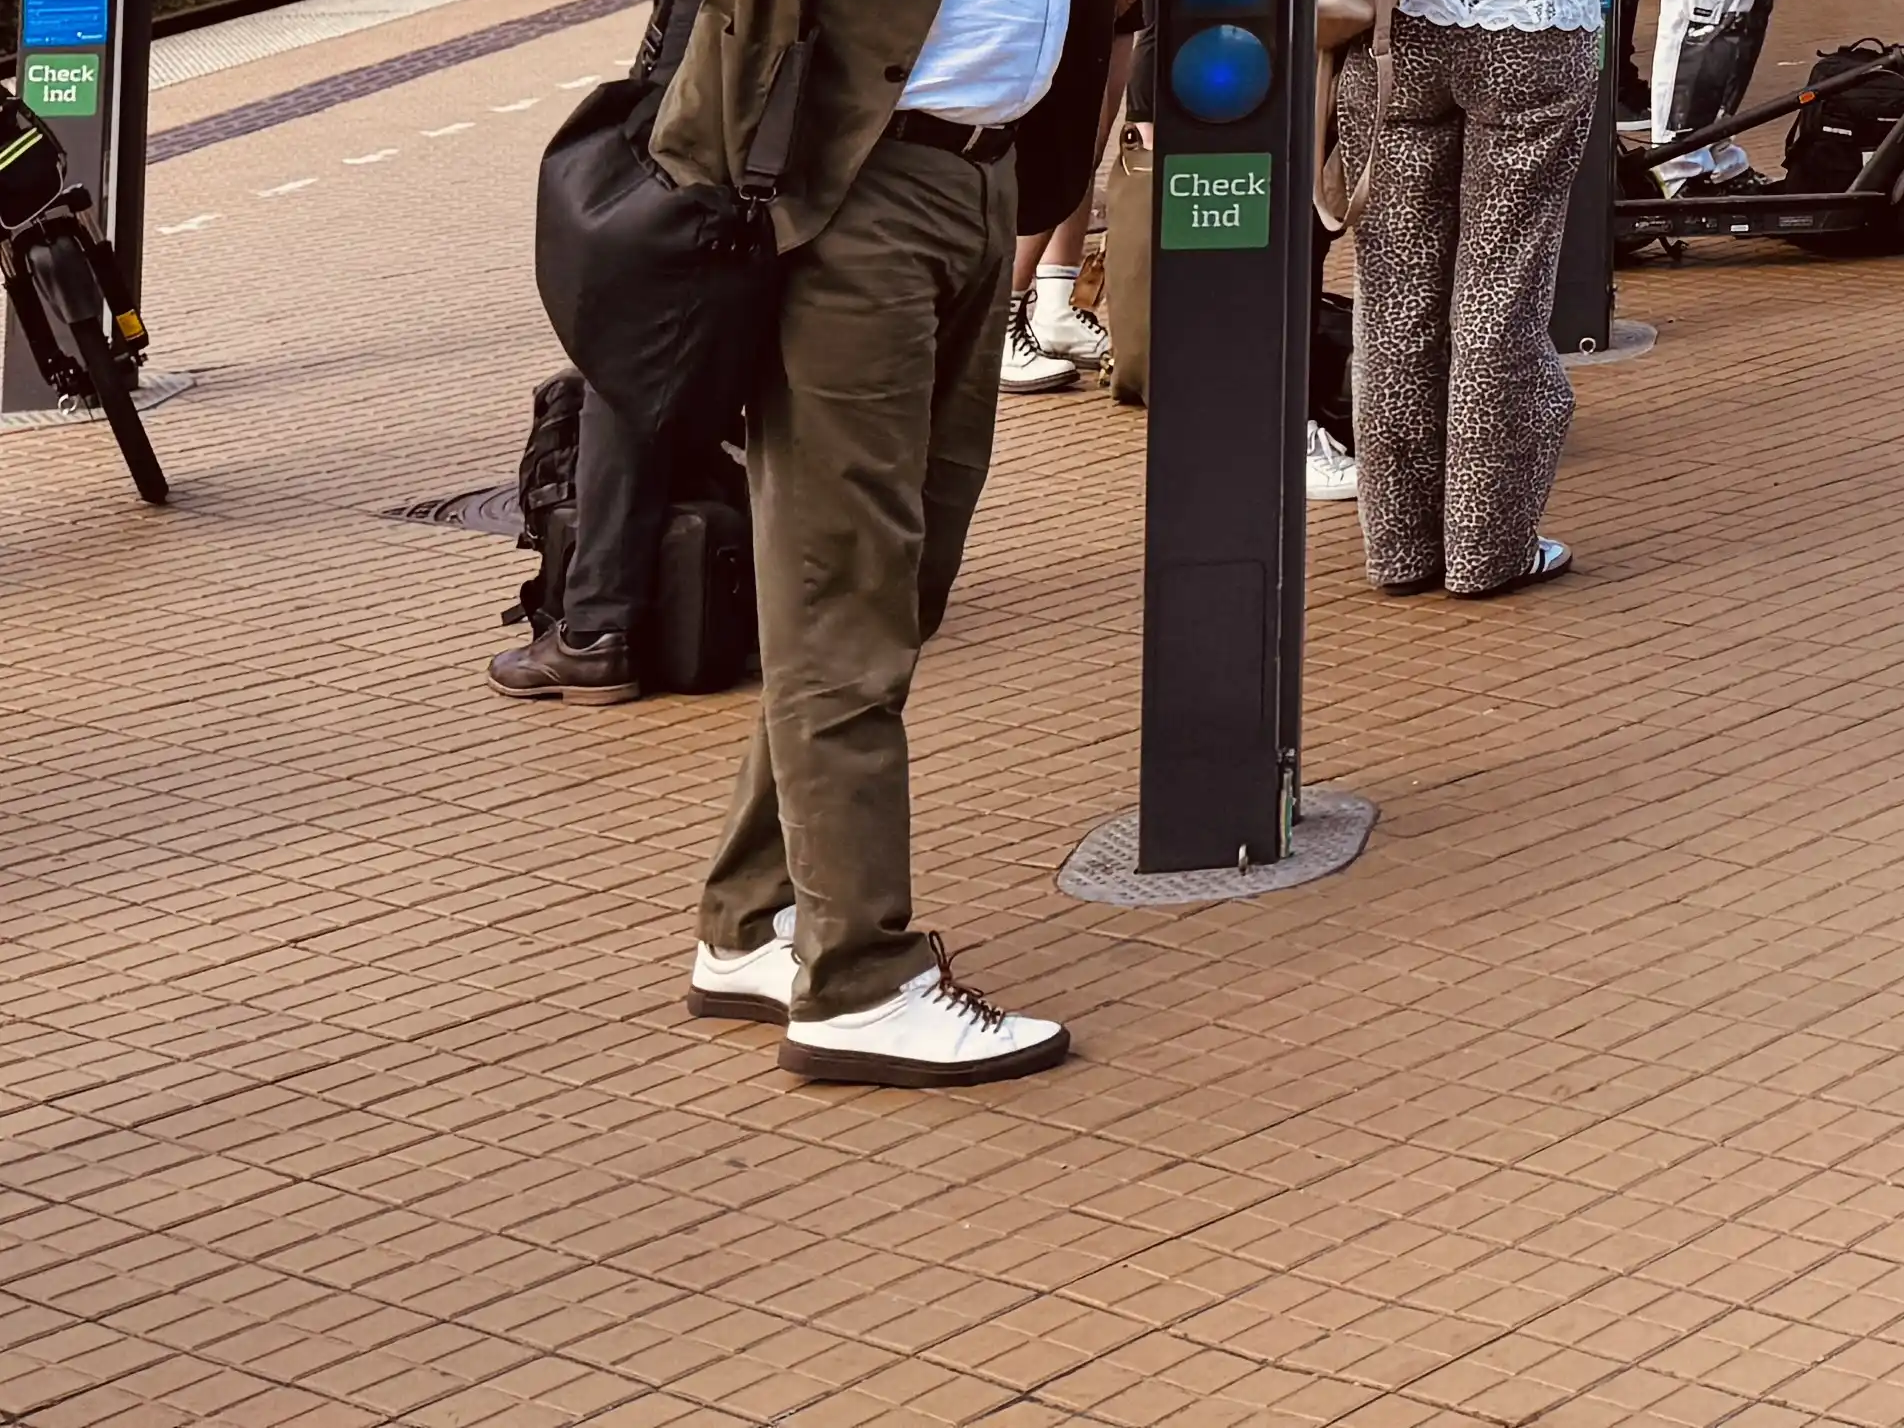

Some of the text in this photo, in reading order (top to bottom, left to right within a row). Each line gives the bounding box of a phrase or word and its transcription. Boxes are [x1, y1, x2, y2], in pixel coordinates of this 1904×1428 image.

[28, 65, 95, 83] Check
[1169, 172, 1266, 198] Check
[1191, 203, 1241, 229] ind
